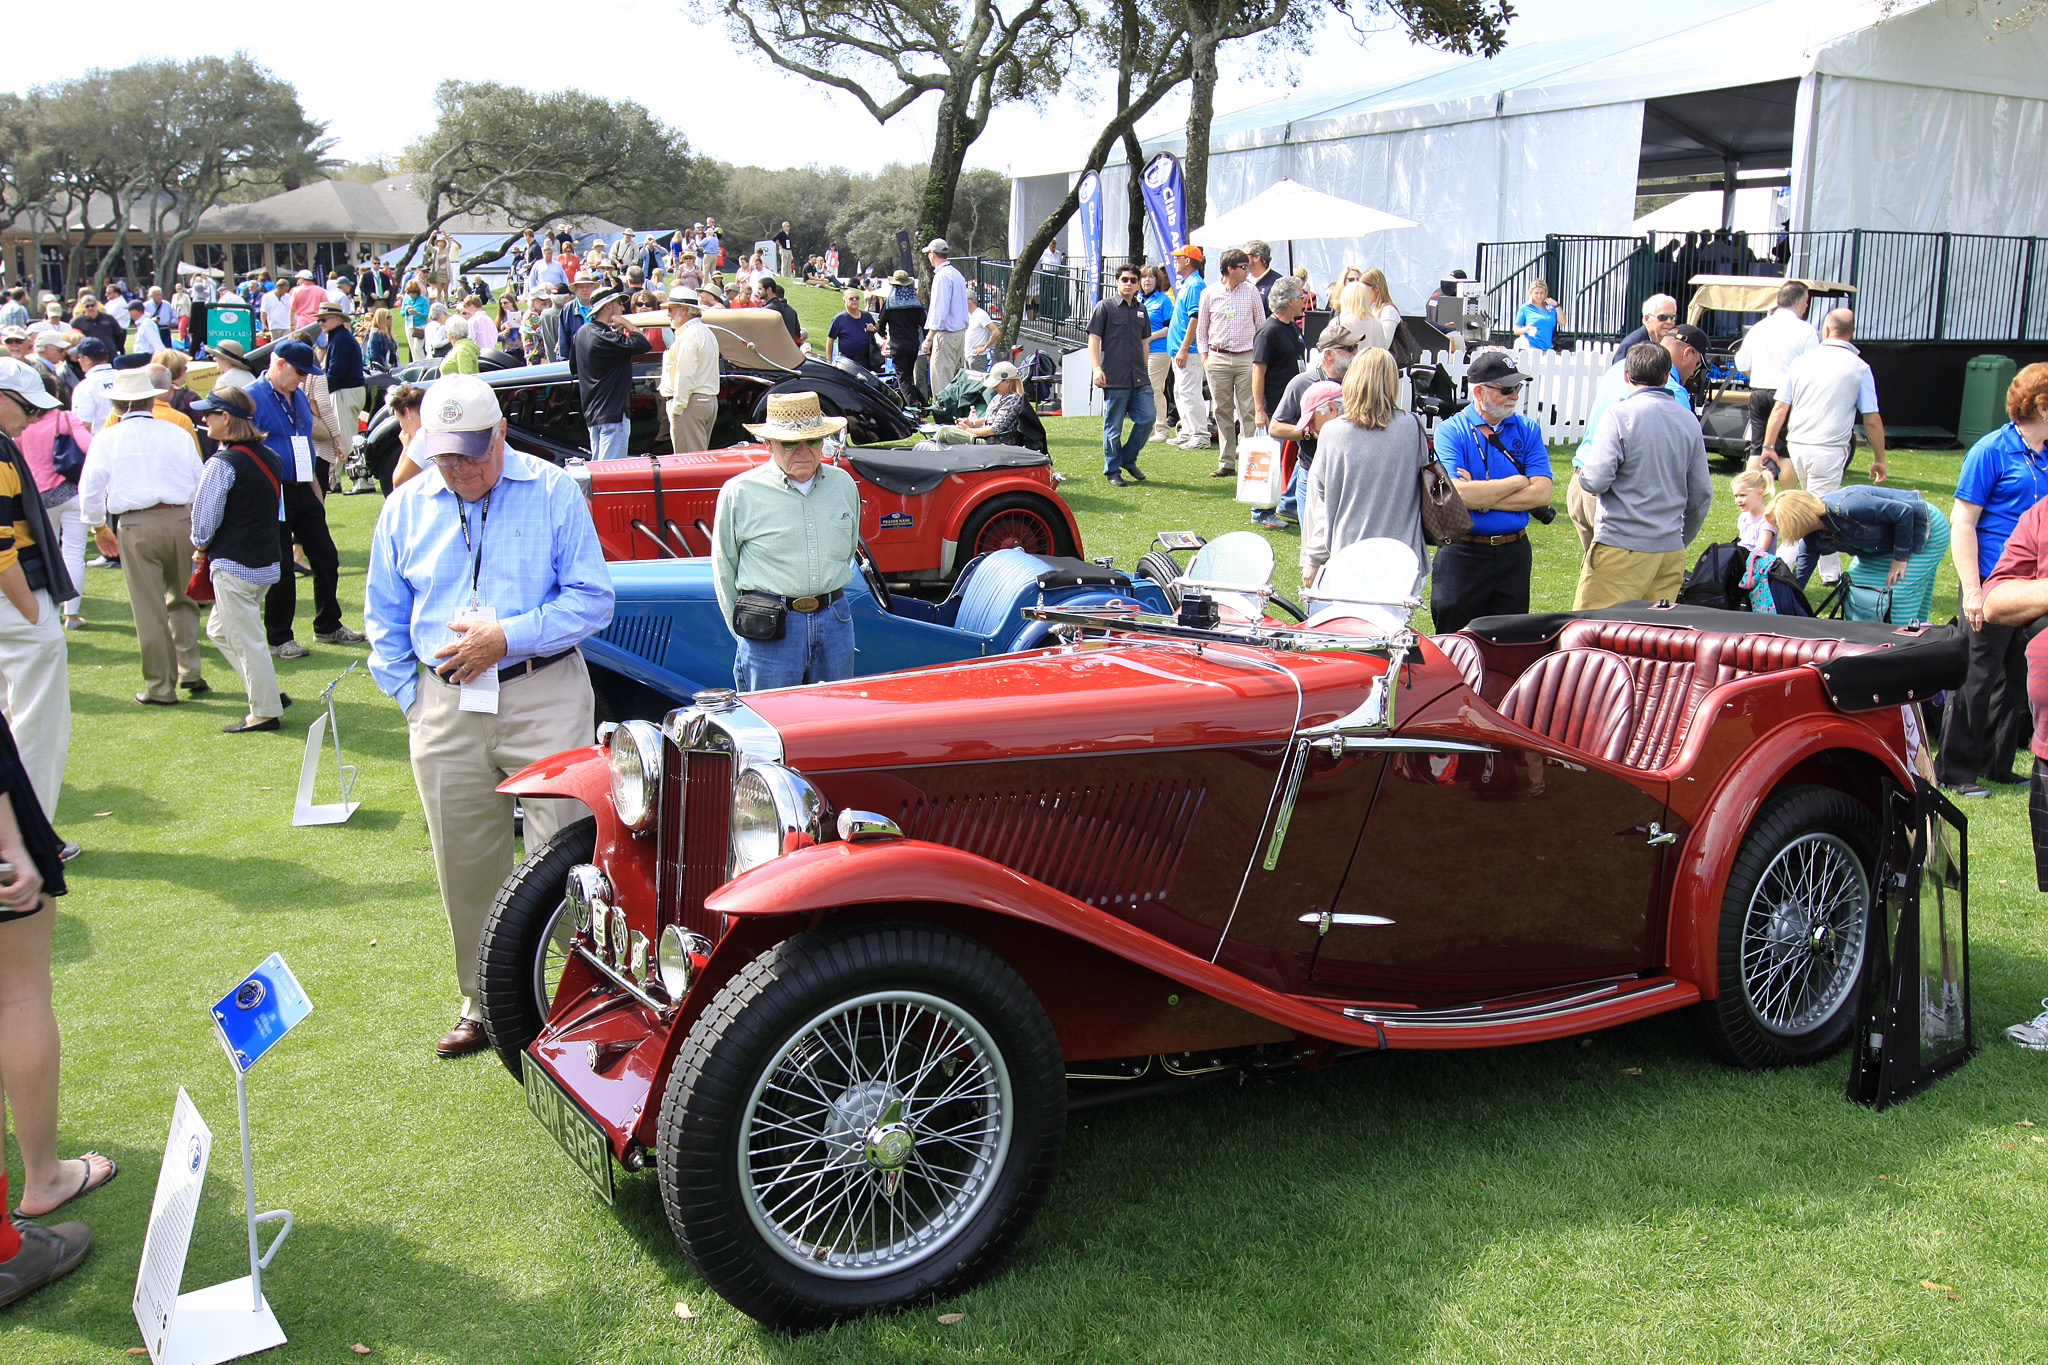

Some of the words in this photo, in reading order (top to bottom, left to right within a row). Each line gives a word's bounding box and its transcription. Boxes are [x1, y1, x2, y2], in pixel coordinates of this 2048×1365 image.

[1162, 186, 1177, 226] Club
[527, 1065, 563, 1144] ABM
[563, 1104, 604, 1186] 588
